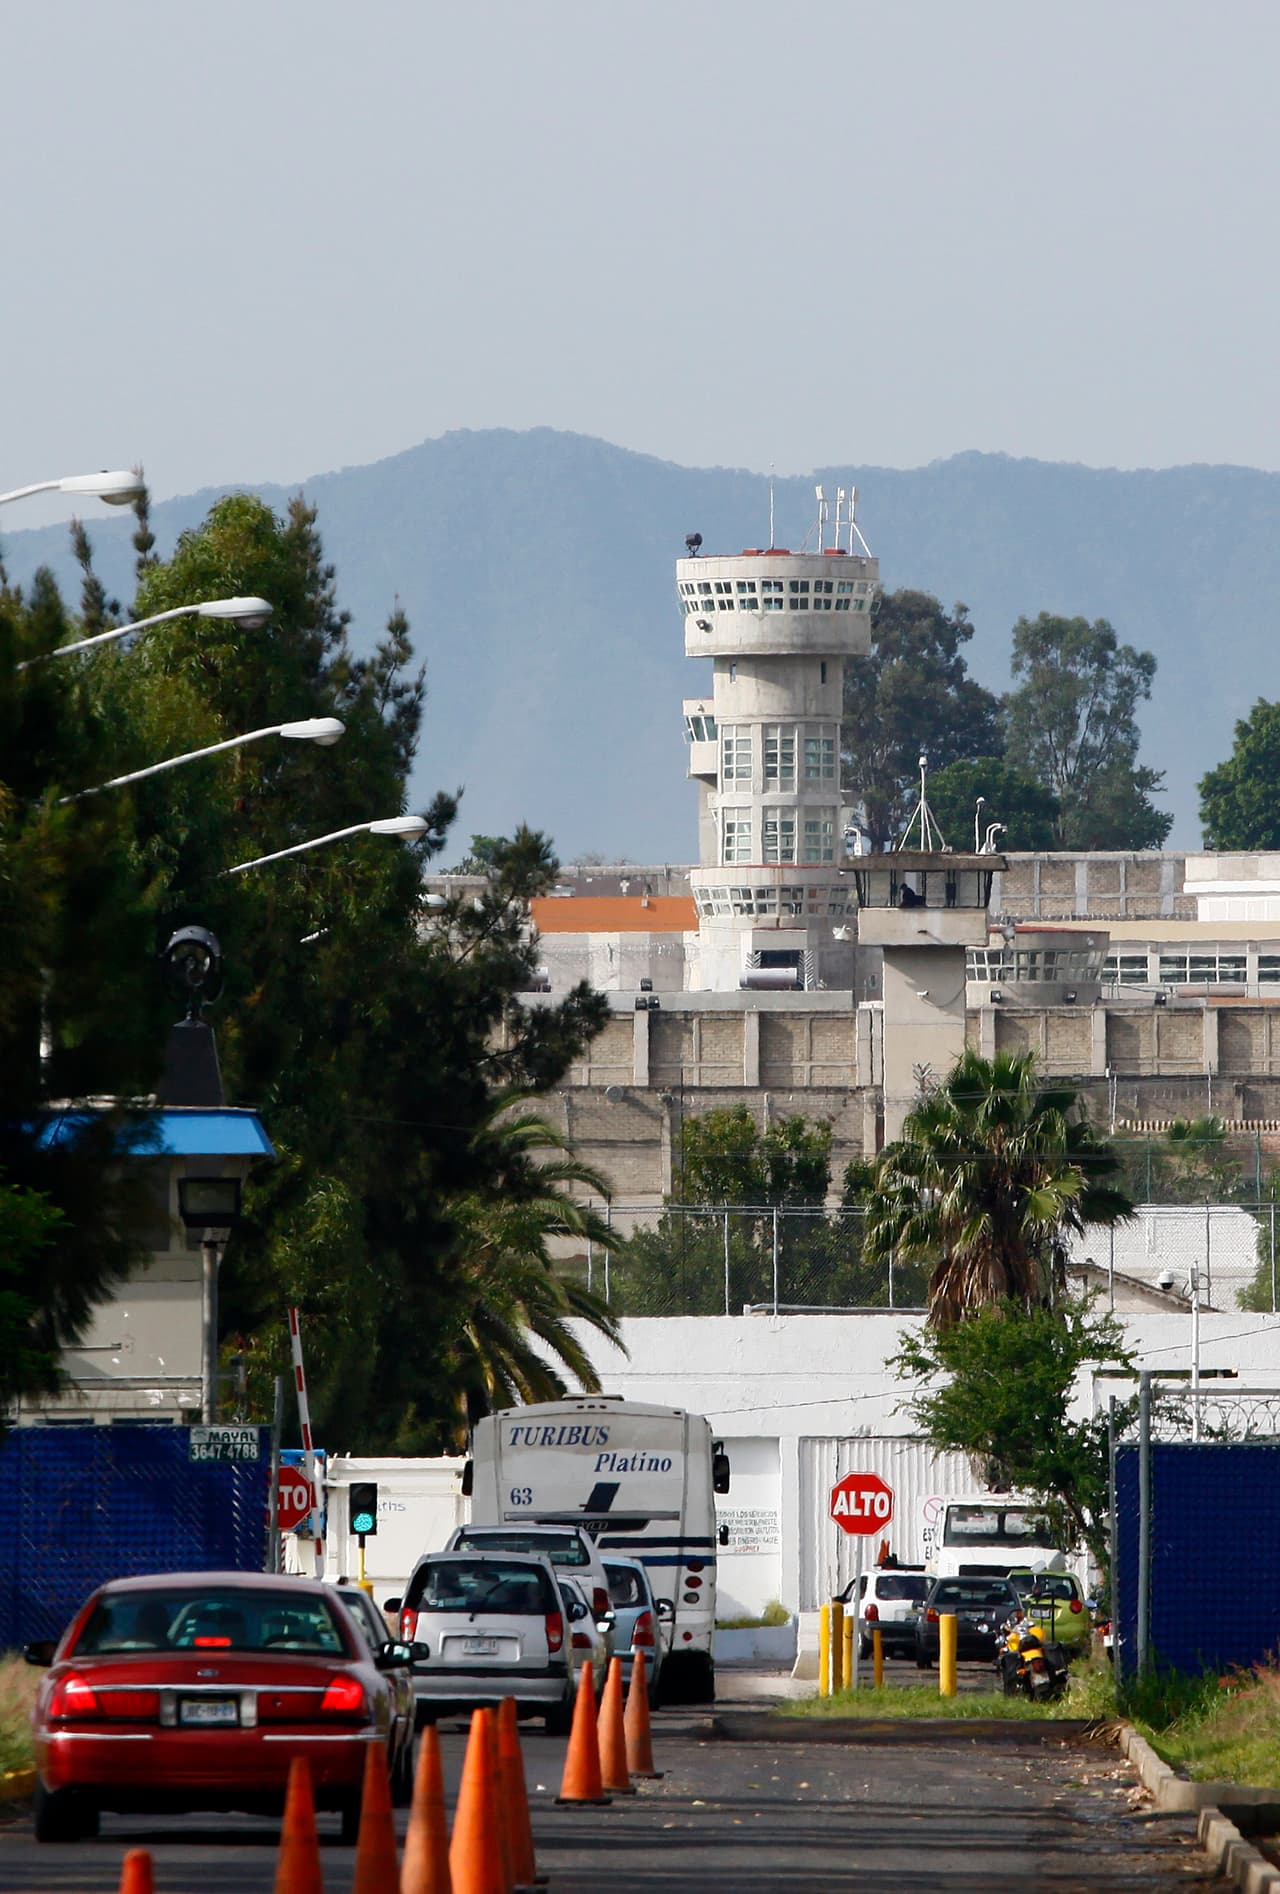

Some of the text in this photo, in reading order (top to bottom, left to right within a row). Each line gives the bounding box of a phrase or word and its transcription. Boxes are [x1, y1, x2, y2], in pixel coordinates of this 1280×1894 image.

[208, 1431, 257, 1442] MAYAL
[509, 1425, 610, 1446] TURIBUS
[594, 1452, 672, 1473] Platino
[510, 1487, 533, 1506] 63
[833, 1490, 891, 1518] ALTO
